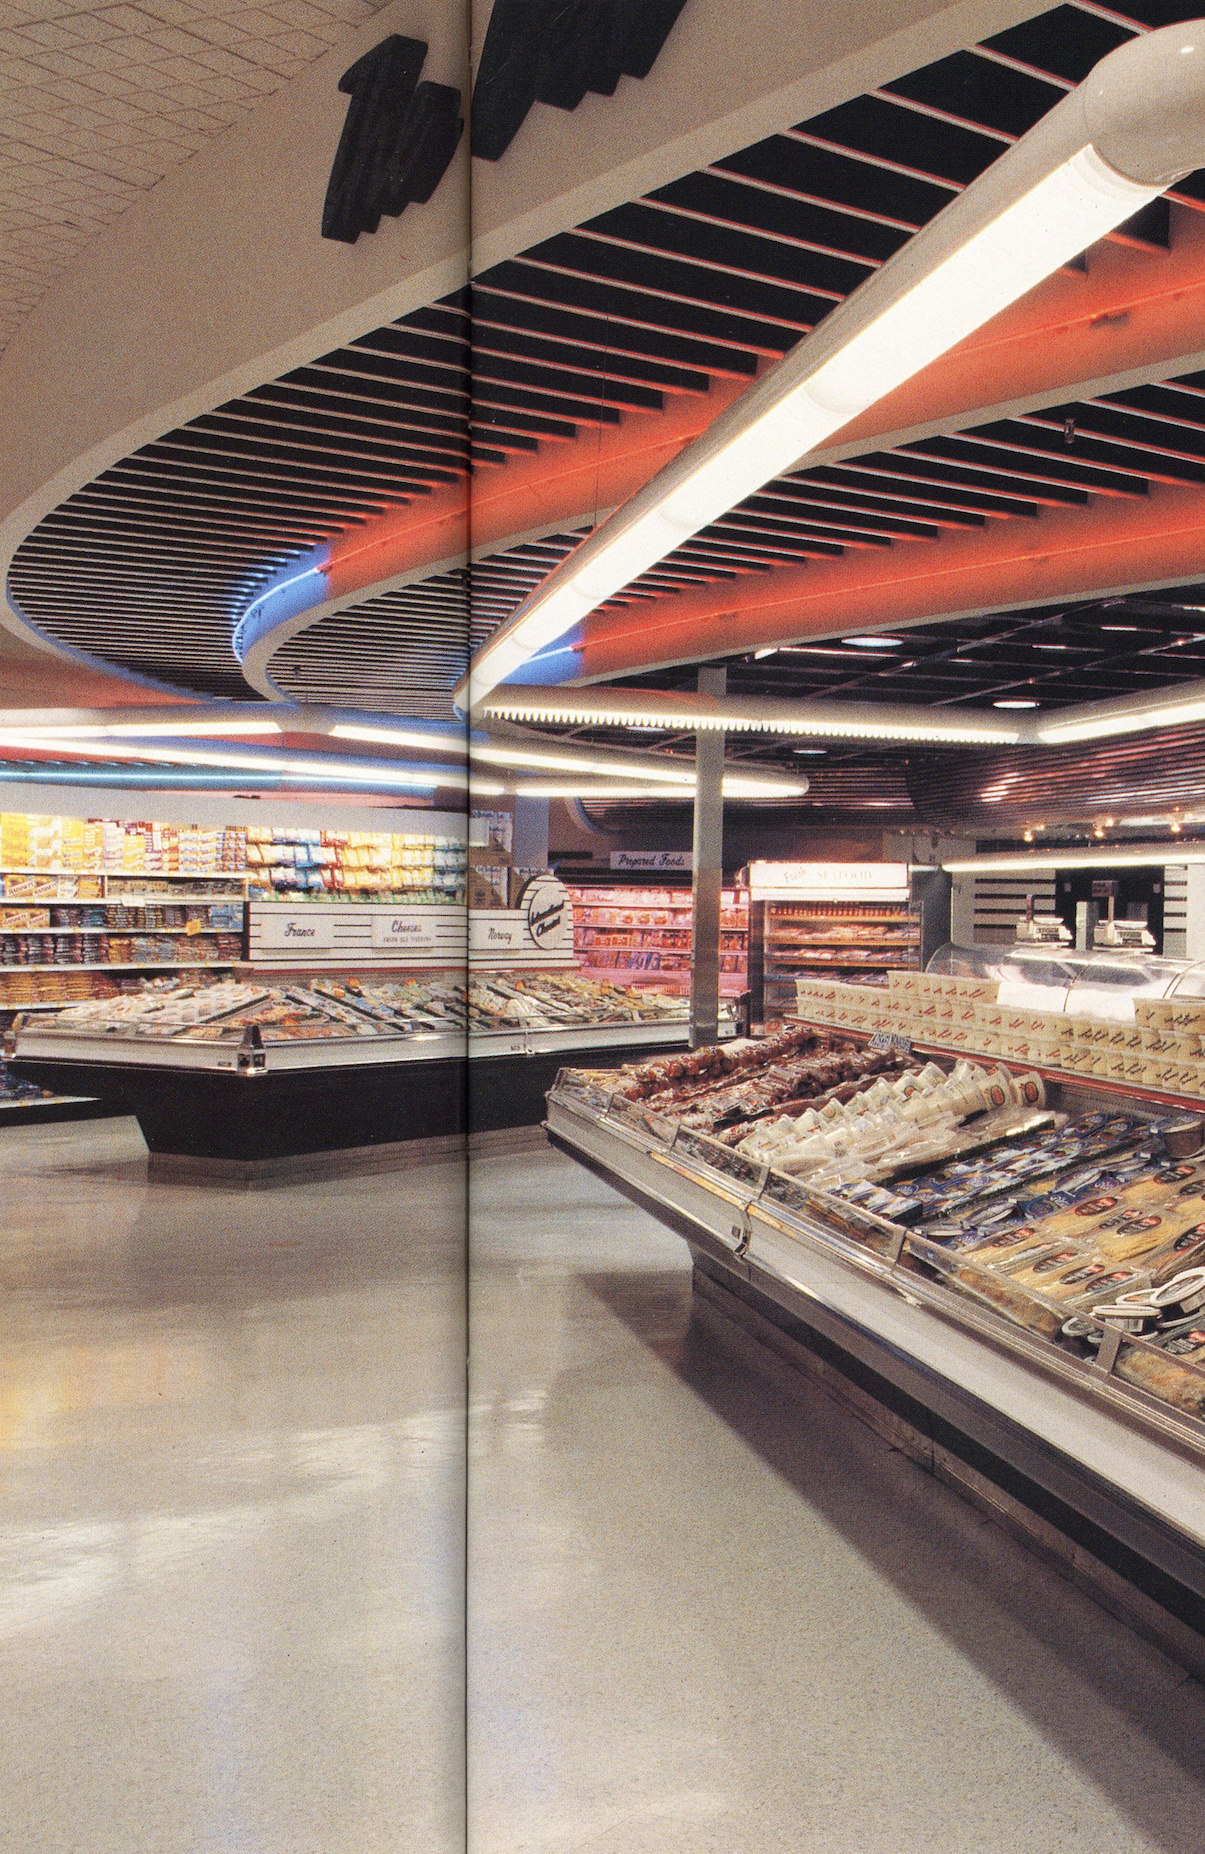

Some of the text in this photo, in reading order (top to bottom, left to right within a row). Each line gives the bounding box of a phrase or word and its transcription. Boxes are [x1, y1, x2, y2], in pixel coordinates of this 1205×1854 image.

[618, 852, 685, 868] Prepared Foods
[284, 922, 316, 938] France
[488, 927, 513, 945] Norway
